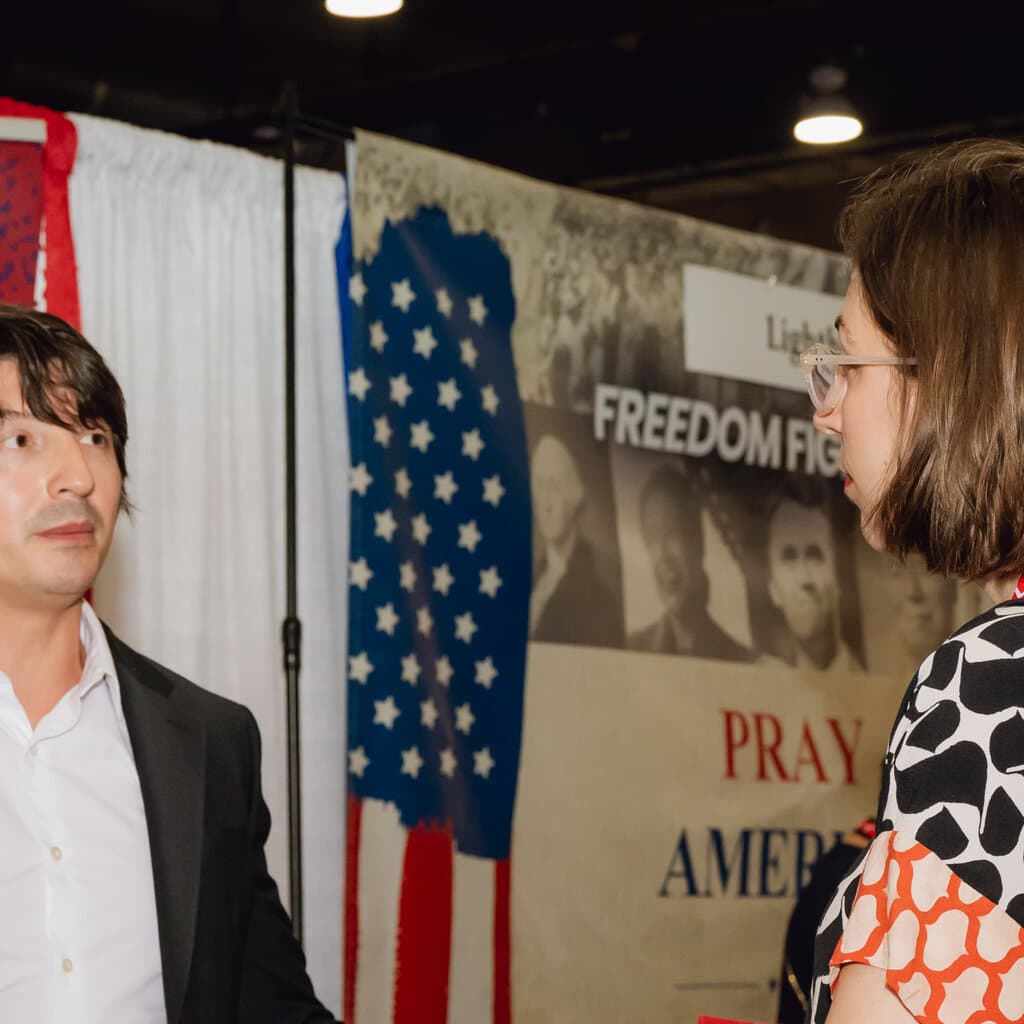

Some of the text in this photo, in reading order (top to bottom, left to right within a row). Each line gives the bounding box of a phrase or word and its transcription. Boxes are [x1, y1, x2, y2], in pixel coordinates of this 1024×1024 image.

[593, 383, 782, 470] FREEDOM
[721, 708, 864, 785] PRAY
[657, 826, 846, 899] AMER
